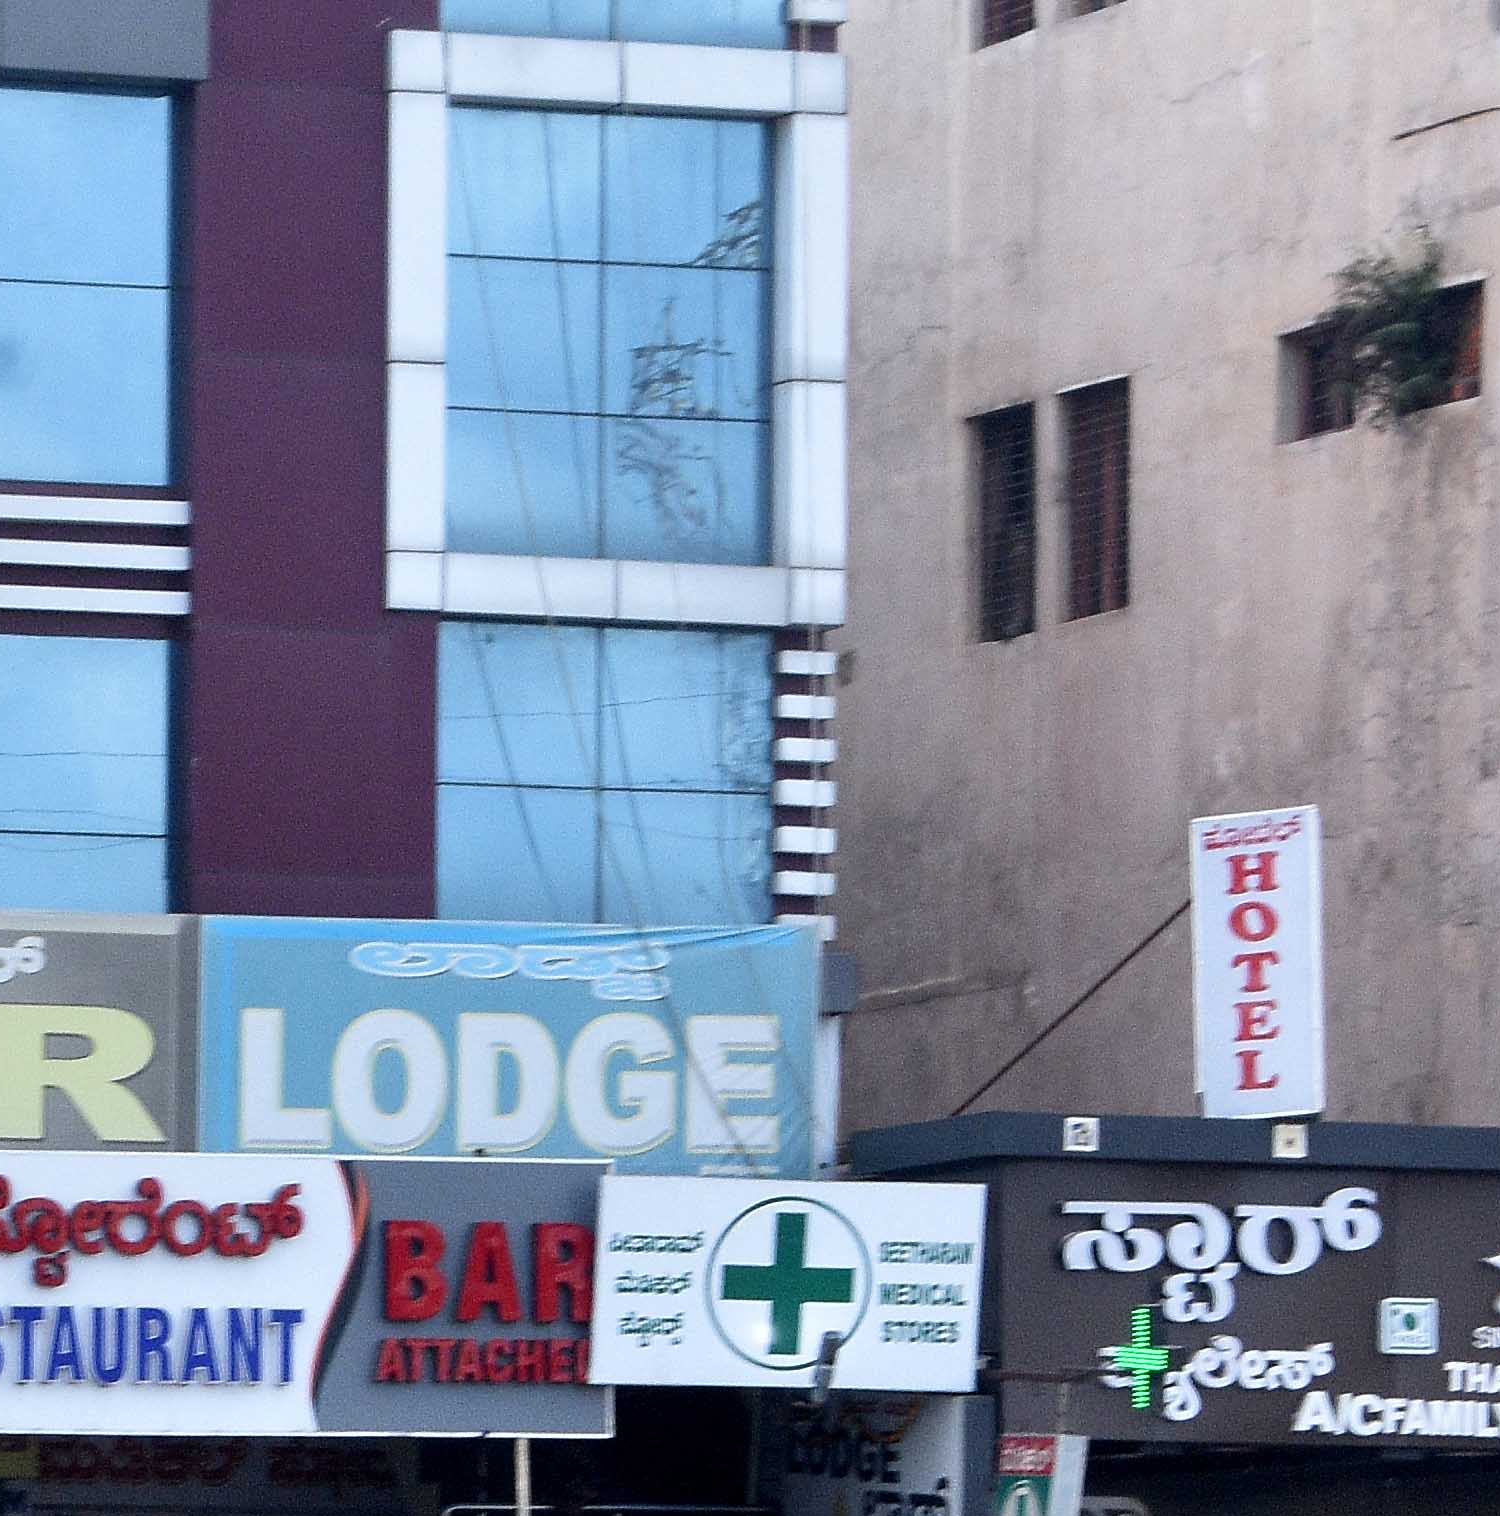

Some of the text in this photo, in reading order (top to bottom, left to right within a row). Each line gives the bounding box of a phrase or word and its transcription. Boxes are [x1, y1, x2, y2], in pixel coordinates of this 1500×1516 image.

[1224, 850, 1282, 1092] HOTEL
[239, 1007, 782, 1156] LODGE
[383, 1220, 597, 1324] BAR
[879, 1282, 967, 1307] MEDICAL
[1060, 1186, 1385, 1324] ಸ್ಟಾರ್
[879, 1320, 962, 1345] STORES
